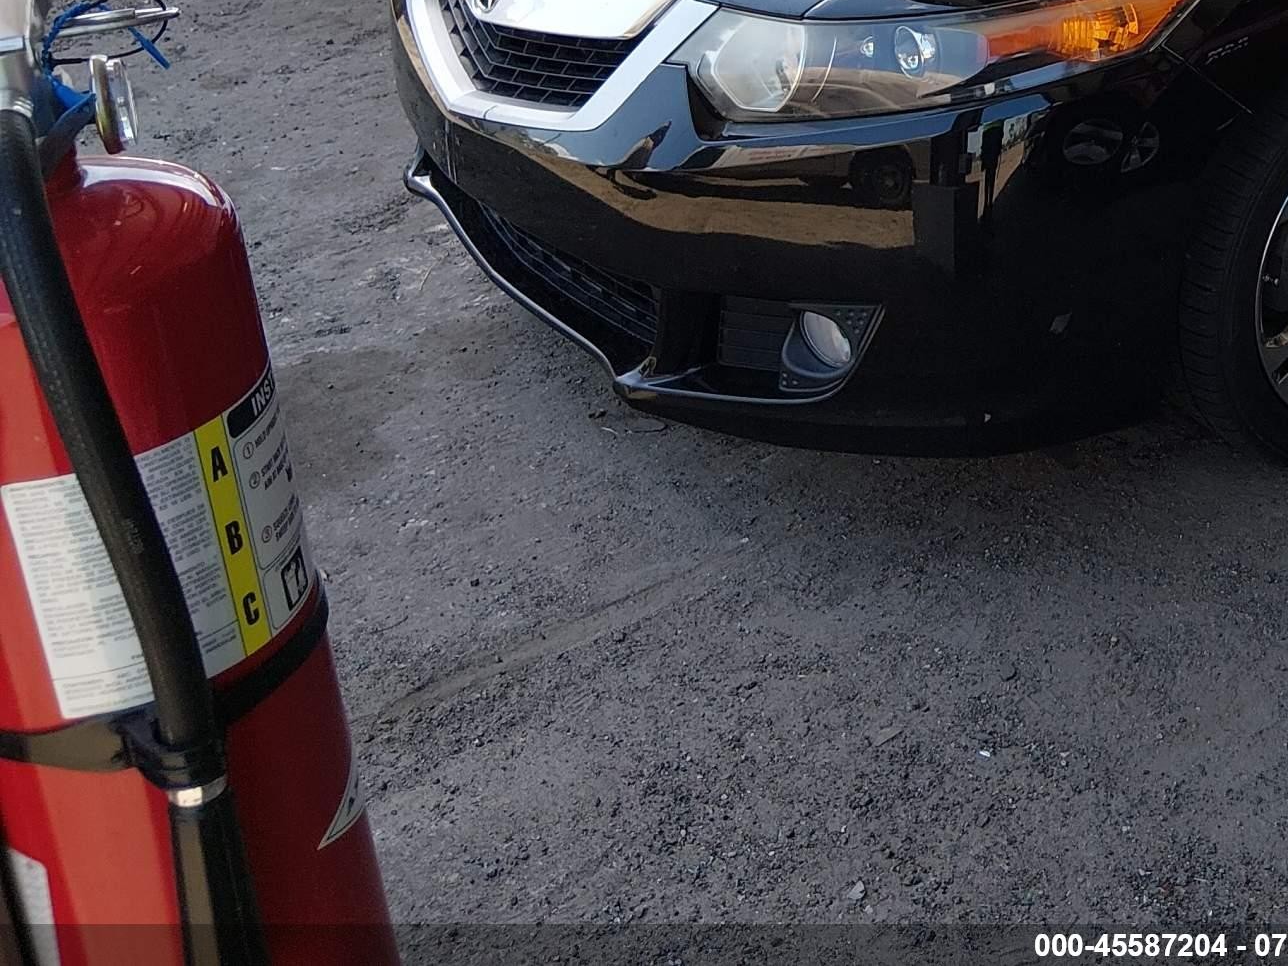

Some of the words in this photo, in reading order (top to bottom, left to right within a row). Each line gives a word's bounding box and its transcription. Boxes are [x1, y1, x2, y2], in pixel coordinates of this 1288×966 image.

[211, 445, 229, 483] A
[225, 520, 243, 555] B
[242, 591, 260, 626] C
